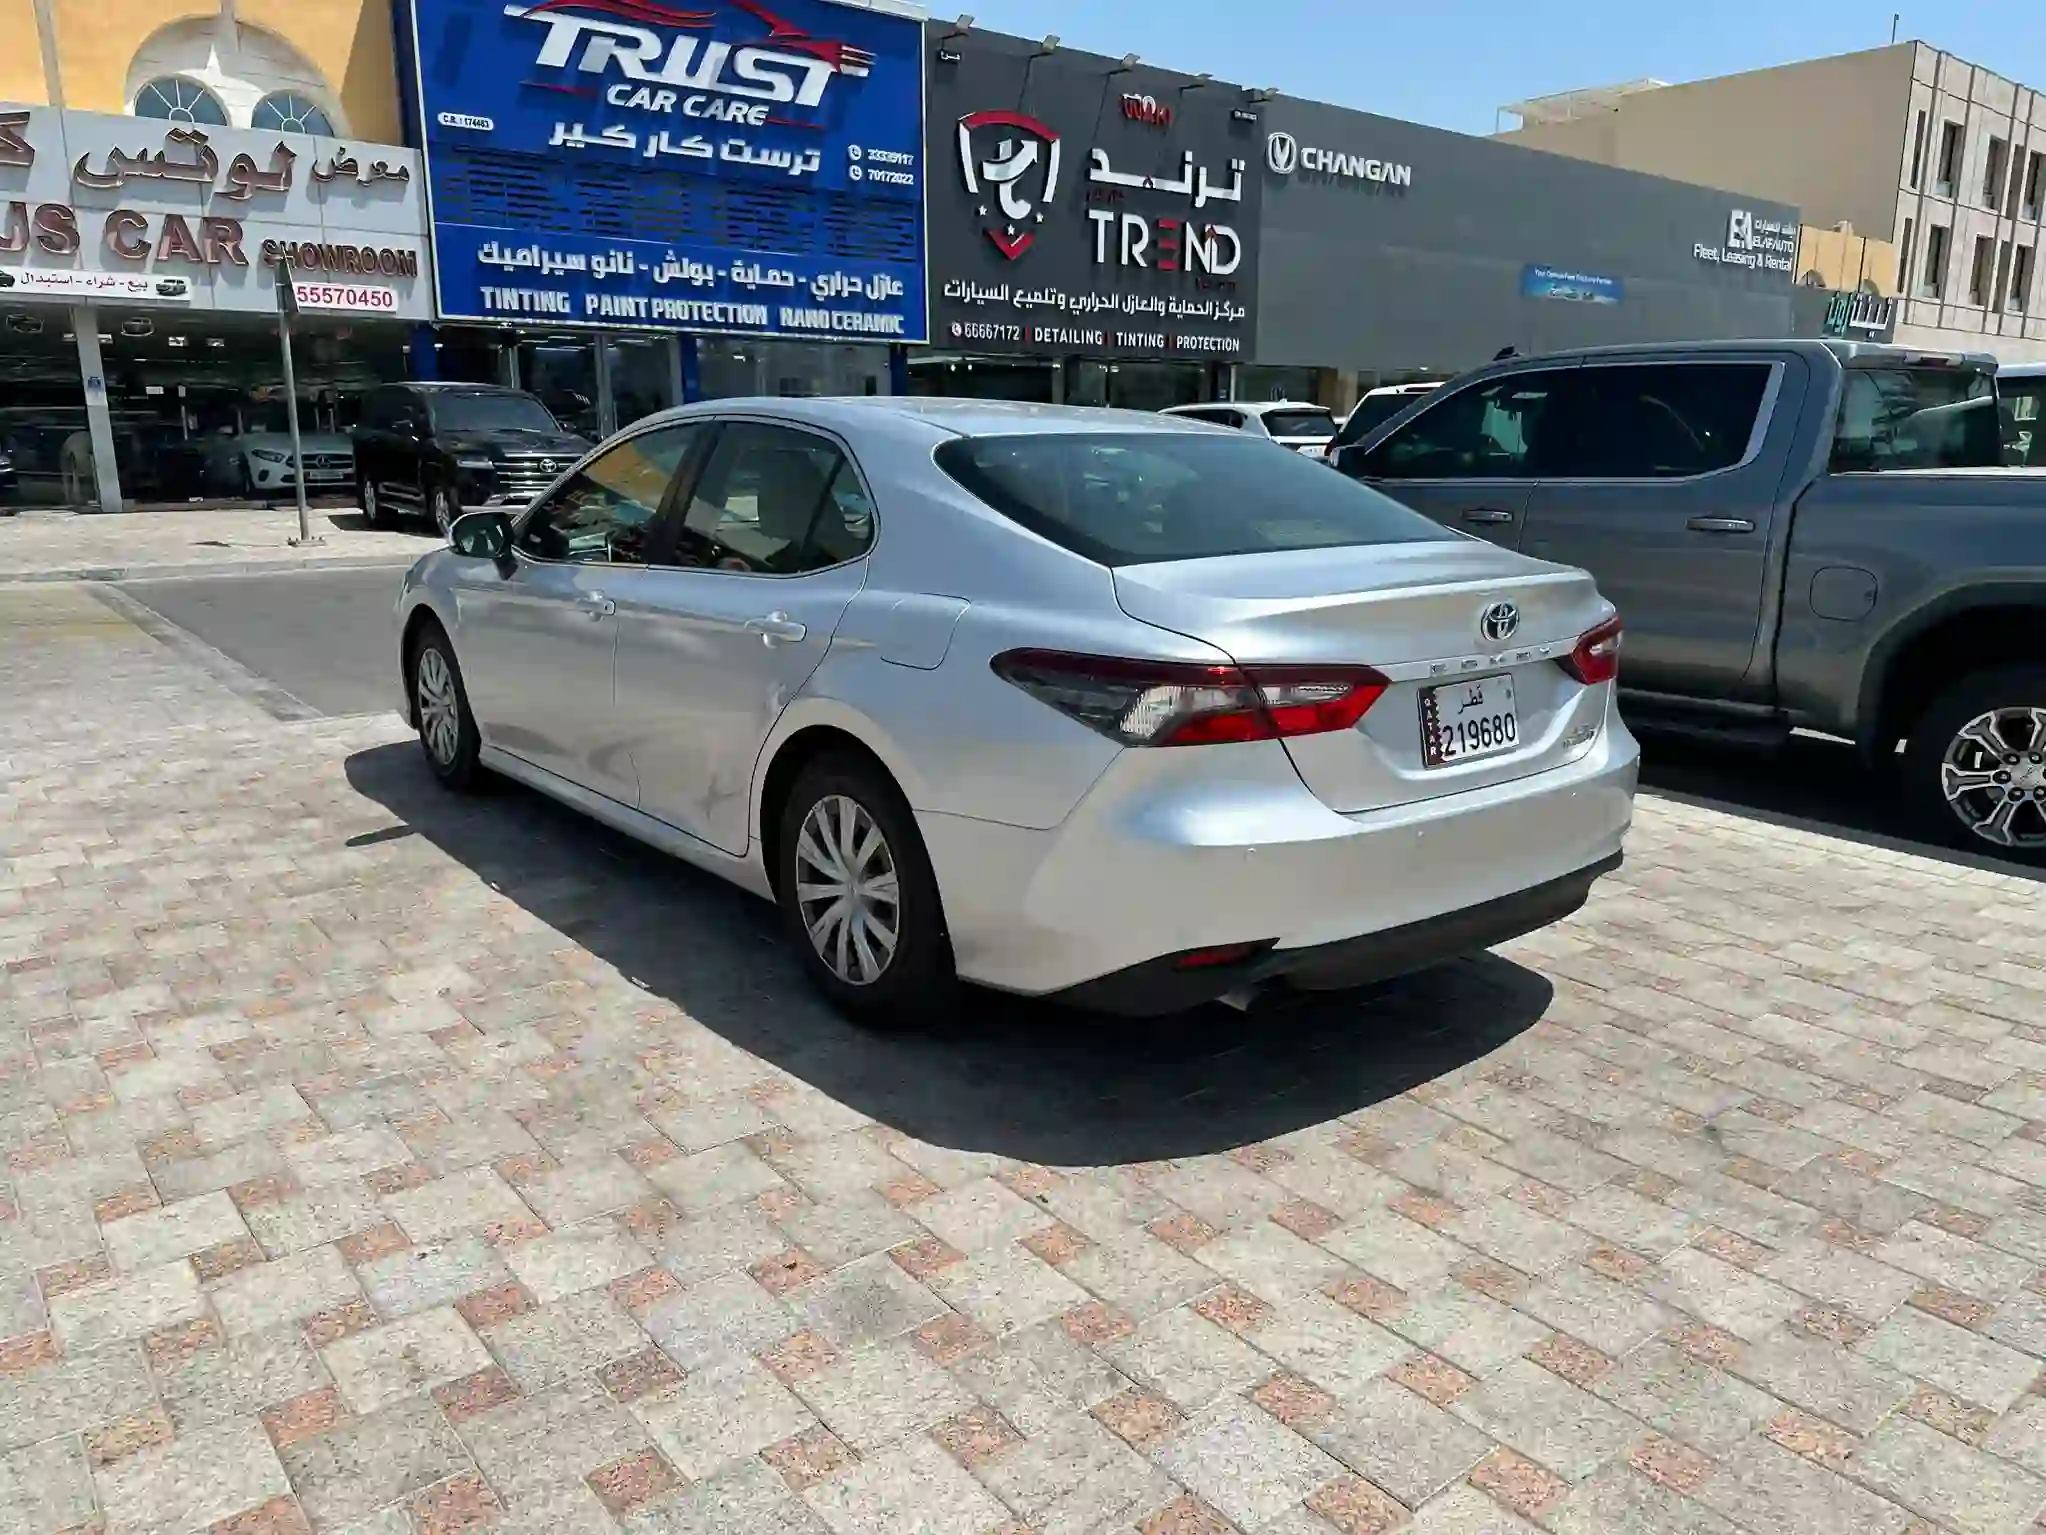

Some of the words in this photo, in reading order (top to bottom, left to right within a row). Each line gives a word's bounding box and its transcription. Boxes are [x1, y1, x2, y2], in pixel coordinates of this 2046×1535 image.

[503, 5, 868, 106] TRUST
[606, 83, 677, 113] CAR
[683, 94, 770, 127] CARE
[548, 121, 637, 149] كير
[643, 130, 713, 159] كار
[312, 144, 410, 187] معرض
[720, 137, 821, 176] ترست
[1301, 147, 1412, 187] CHANGAN
[1090, 148, 1245, 209] ترند
[105, 208, 250, 267] CAR
[262, 238, 418, 279] SHOWROOM
[1088, 207, 1242, 276] TREND
[477, 240, 586, 277] سيراميك
[590, 249, 635, 279] نانو
[653, 249, 715, 288] بولش
[1764, 254, 1793, 272] Rental
[20, 271, 73, 287] استبدال
[86, 274, 116, 290] شراء
[127, 278, 149, 293] بيع
[730, 259, 795, 291] حماية
[810, 270, 863, 301] حراري
[865, 272, 904, 301] عازل
[297, 285, 394, 308] 55570450
[943, 279, 1009, 305] السيارات
[1012, 287, 1066, 311] وتلميع
[1069, 291, 1119, 316] الحراري
[1121, 293, 1166, 317] والعازل
[480, 286, 571, 314] TINTING
[585, 293, 649, 319] PAINT
[651, 297, 769, 327] PROTECTION
[780, 306, 830, 330] NANO
[831, 310, 905, 335] CERAMIC
[1168, 295, 1213, 320] الحماية
[1213, 299, 1246, 322] مركز
[964, 322, 1020, 341] 66667172
[1034, 327, 1103, 346] DETAILING
[1115, 331, 1165, 348] TINTING
[1176, 335, 1240, 352] PROTECTION
[1457, 684, 1484, 715] قطر
[1424, 698, 1438, 756] QATAR
[1441, 712, 1516, 757] 219680
